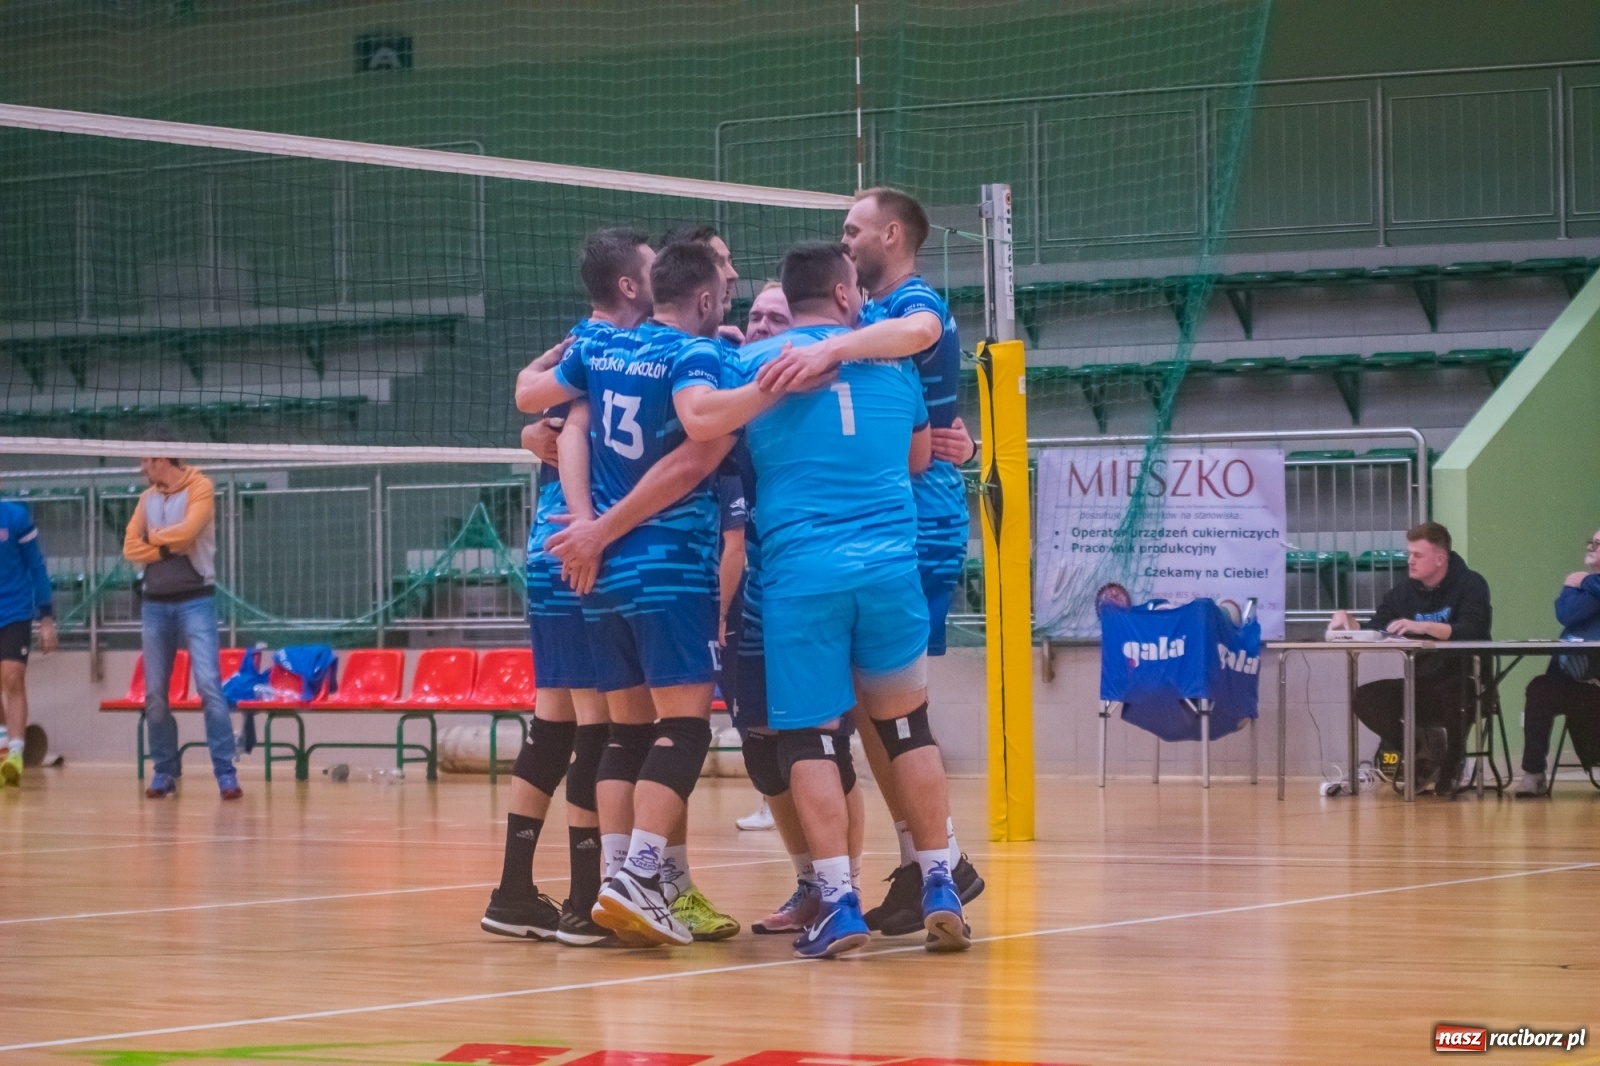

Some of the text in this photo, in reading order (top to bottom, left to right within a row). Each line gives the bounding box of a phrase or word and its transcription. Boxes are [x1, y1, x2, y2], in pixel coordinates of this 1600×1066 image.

[830, 382, 856, 436] 1
[602, 389, 644, 460] 13
[1068, 459, 1255, 499] MIESZKO
[1192, 527, 1280, 541] cukierniczych
[1140, 542, 1217, 556] produkcyjny
[1144, 566, 1269, 580] Czekamy na Ciebie!
[1123, 636, 1186, 668] gala
[1383, 753, 1399, 764] 3D
